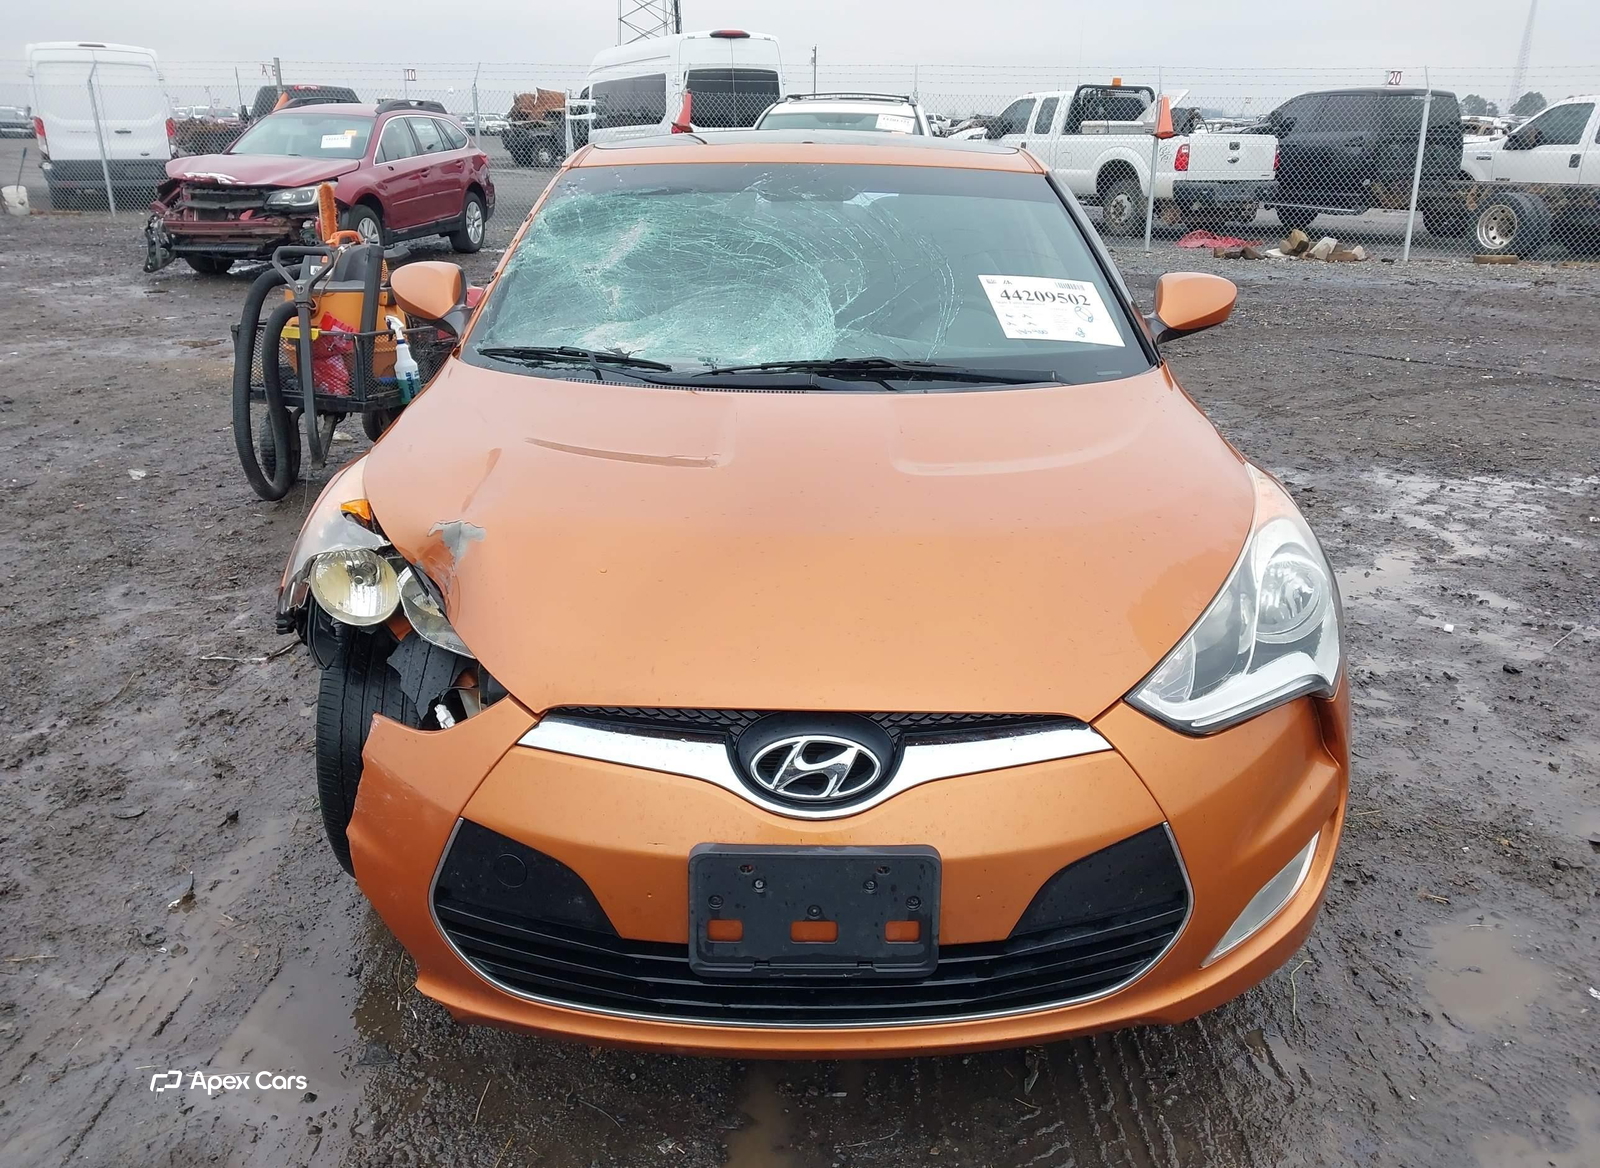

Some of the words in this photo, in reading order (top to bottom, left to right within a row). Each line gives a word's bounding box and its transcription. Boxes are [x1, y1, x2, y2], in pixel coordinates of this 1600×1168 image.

[1388, 71, 1402, 85] 20
[1000, 289, 1091, 306] 44209502
[405, 371, 415, 398] COLAB
